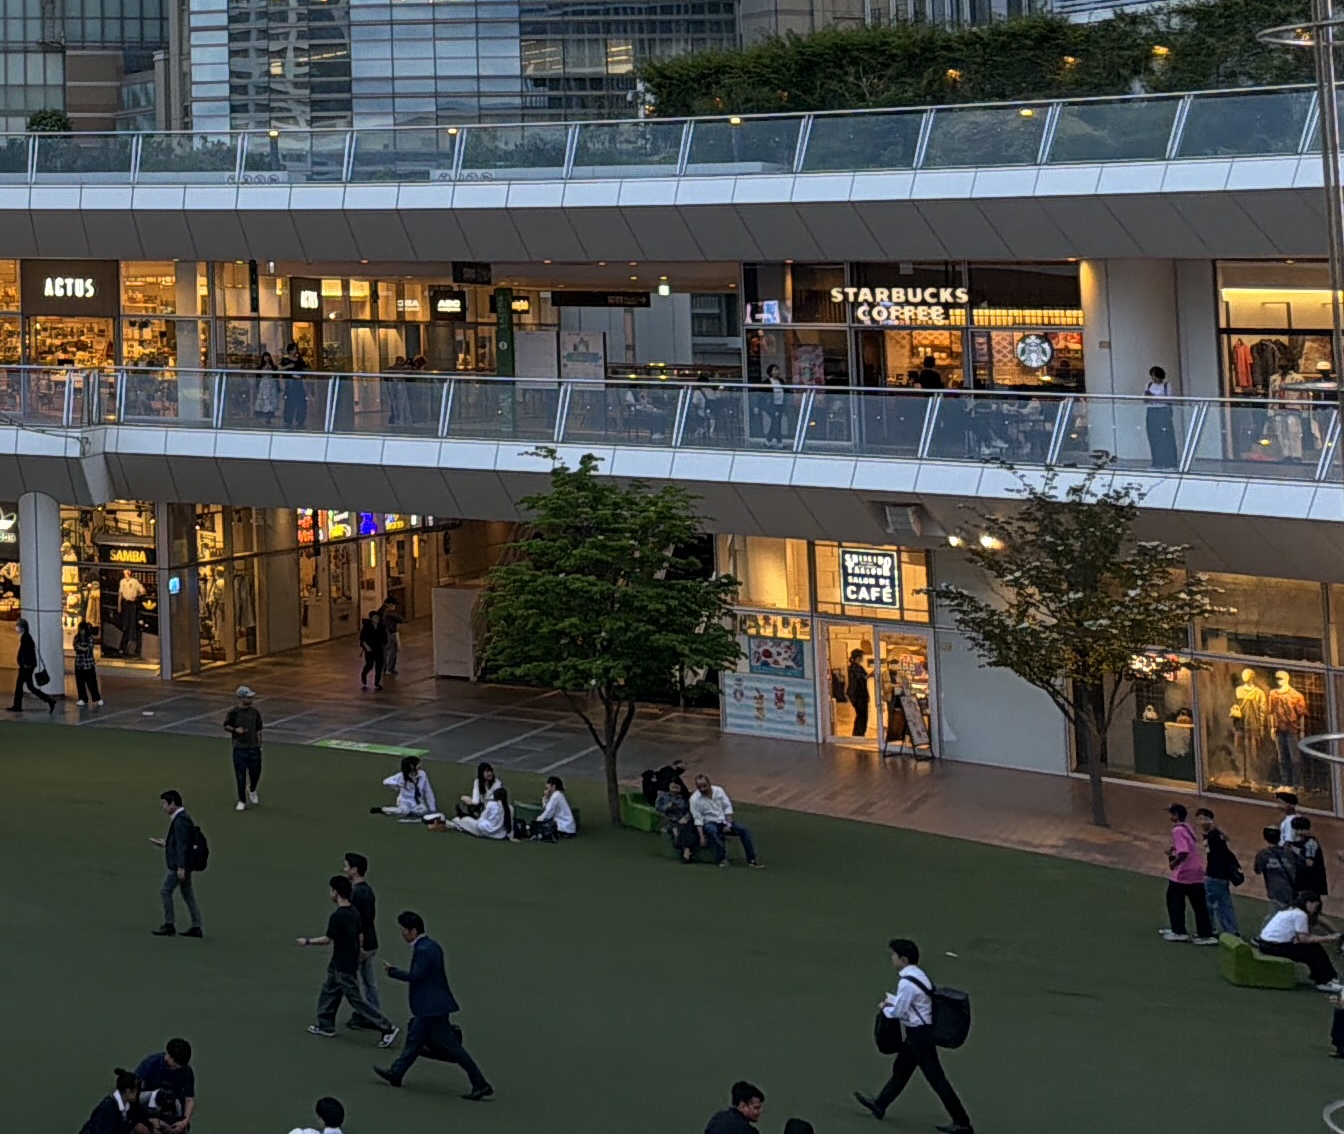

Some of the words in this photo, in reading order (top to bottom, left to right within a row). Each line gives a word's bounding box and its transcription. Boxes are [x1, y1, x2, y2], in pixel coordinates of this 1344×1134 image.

[44, 277, 95, 298] ACTUS
[830, 287, 970, 304] STARBUCKS
[857, 305, 945, 322] COFFEE
[109, 549, 148, 564] SAMBA
[846, 585, 893, 603] CAFÉ
